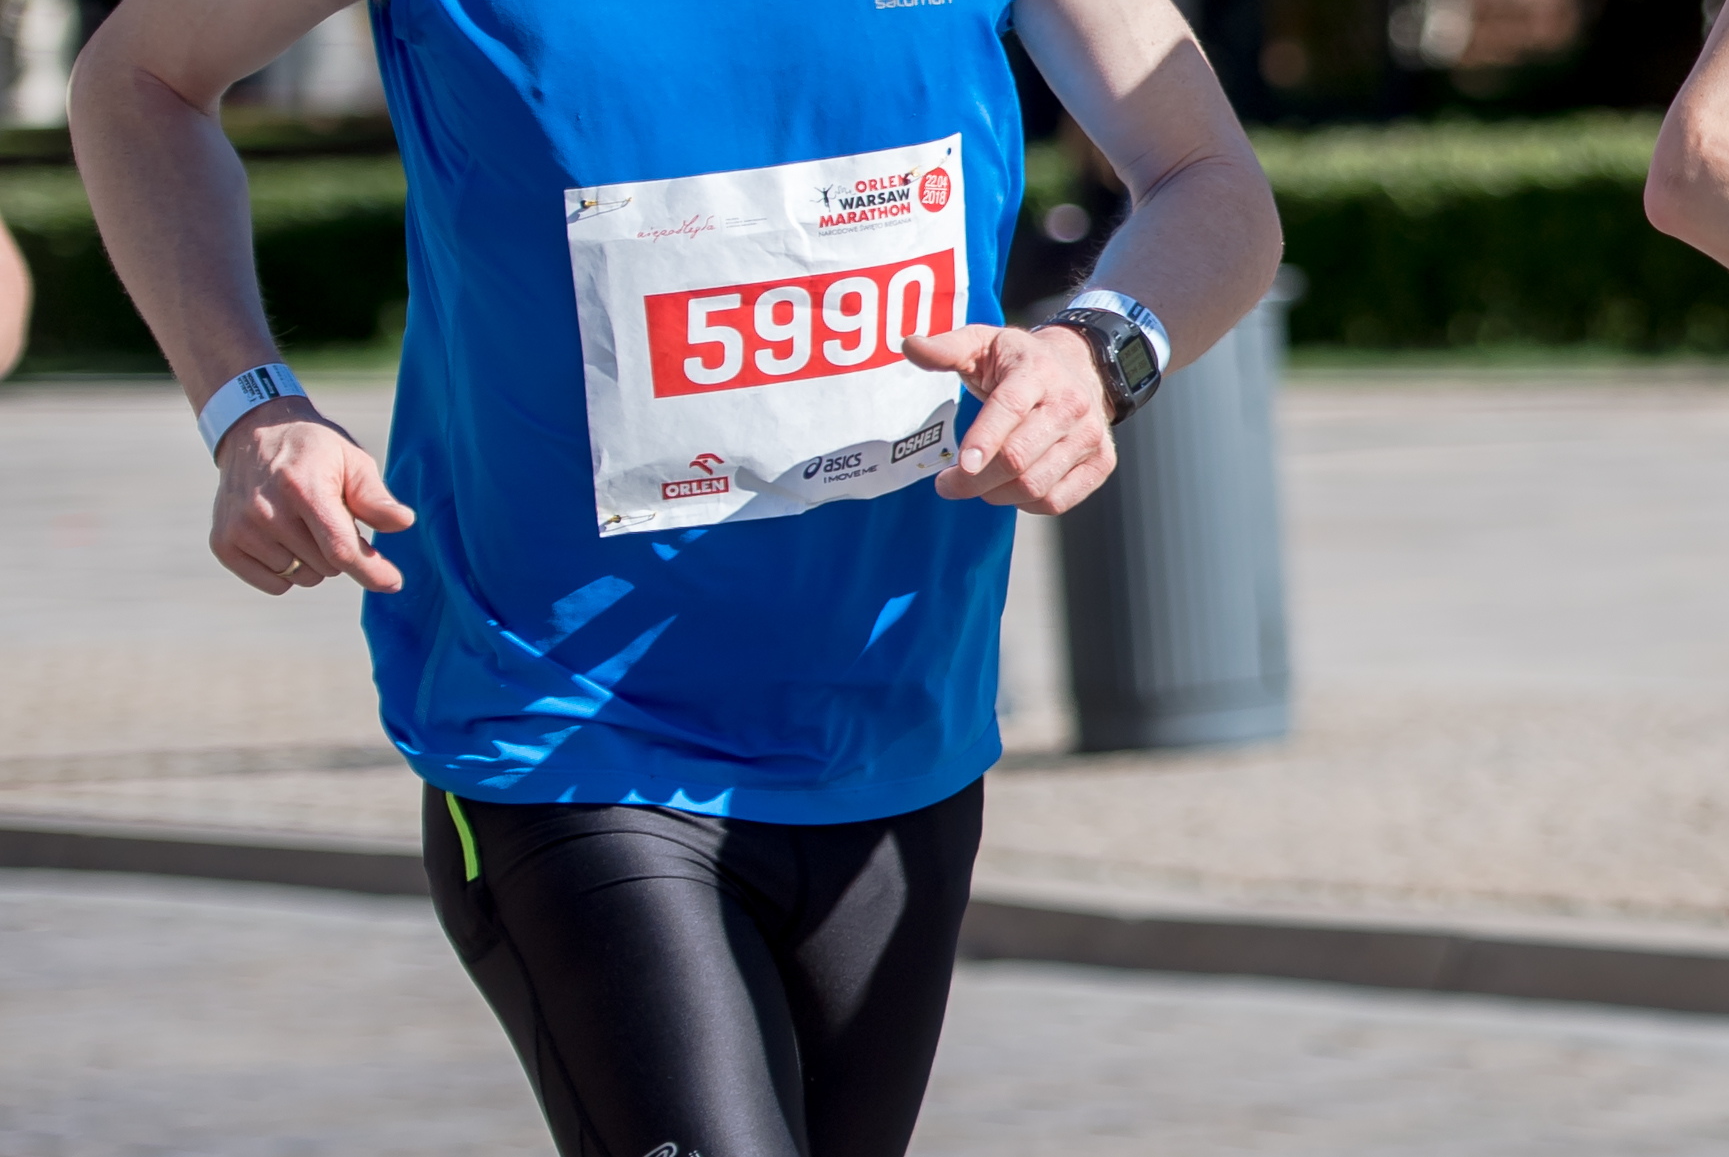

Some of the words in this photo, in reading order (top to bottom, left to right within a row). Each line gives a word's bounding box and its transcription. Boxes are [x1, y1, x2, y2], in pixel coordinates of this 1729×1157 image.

[838, 187, 911, 211] WARSAW
[922, 190, 947, 205] 2018
[818, 201, 912, 229] MARATHON
[682, 263, 936, 385] 5990
[894, 424, 942, 459] OSHEE
[823, 452, 863, 473] asics
[823, 476, 828, 484] I
[828, 468, 861, 483] MOVE
[861, 463, 880, 474] ME
[665, 478, 727, 498] ORLEN
